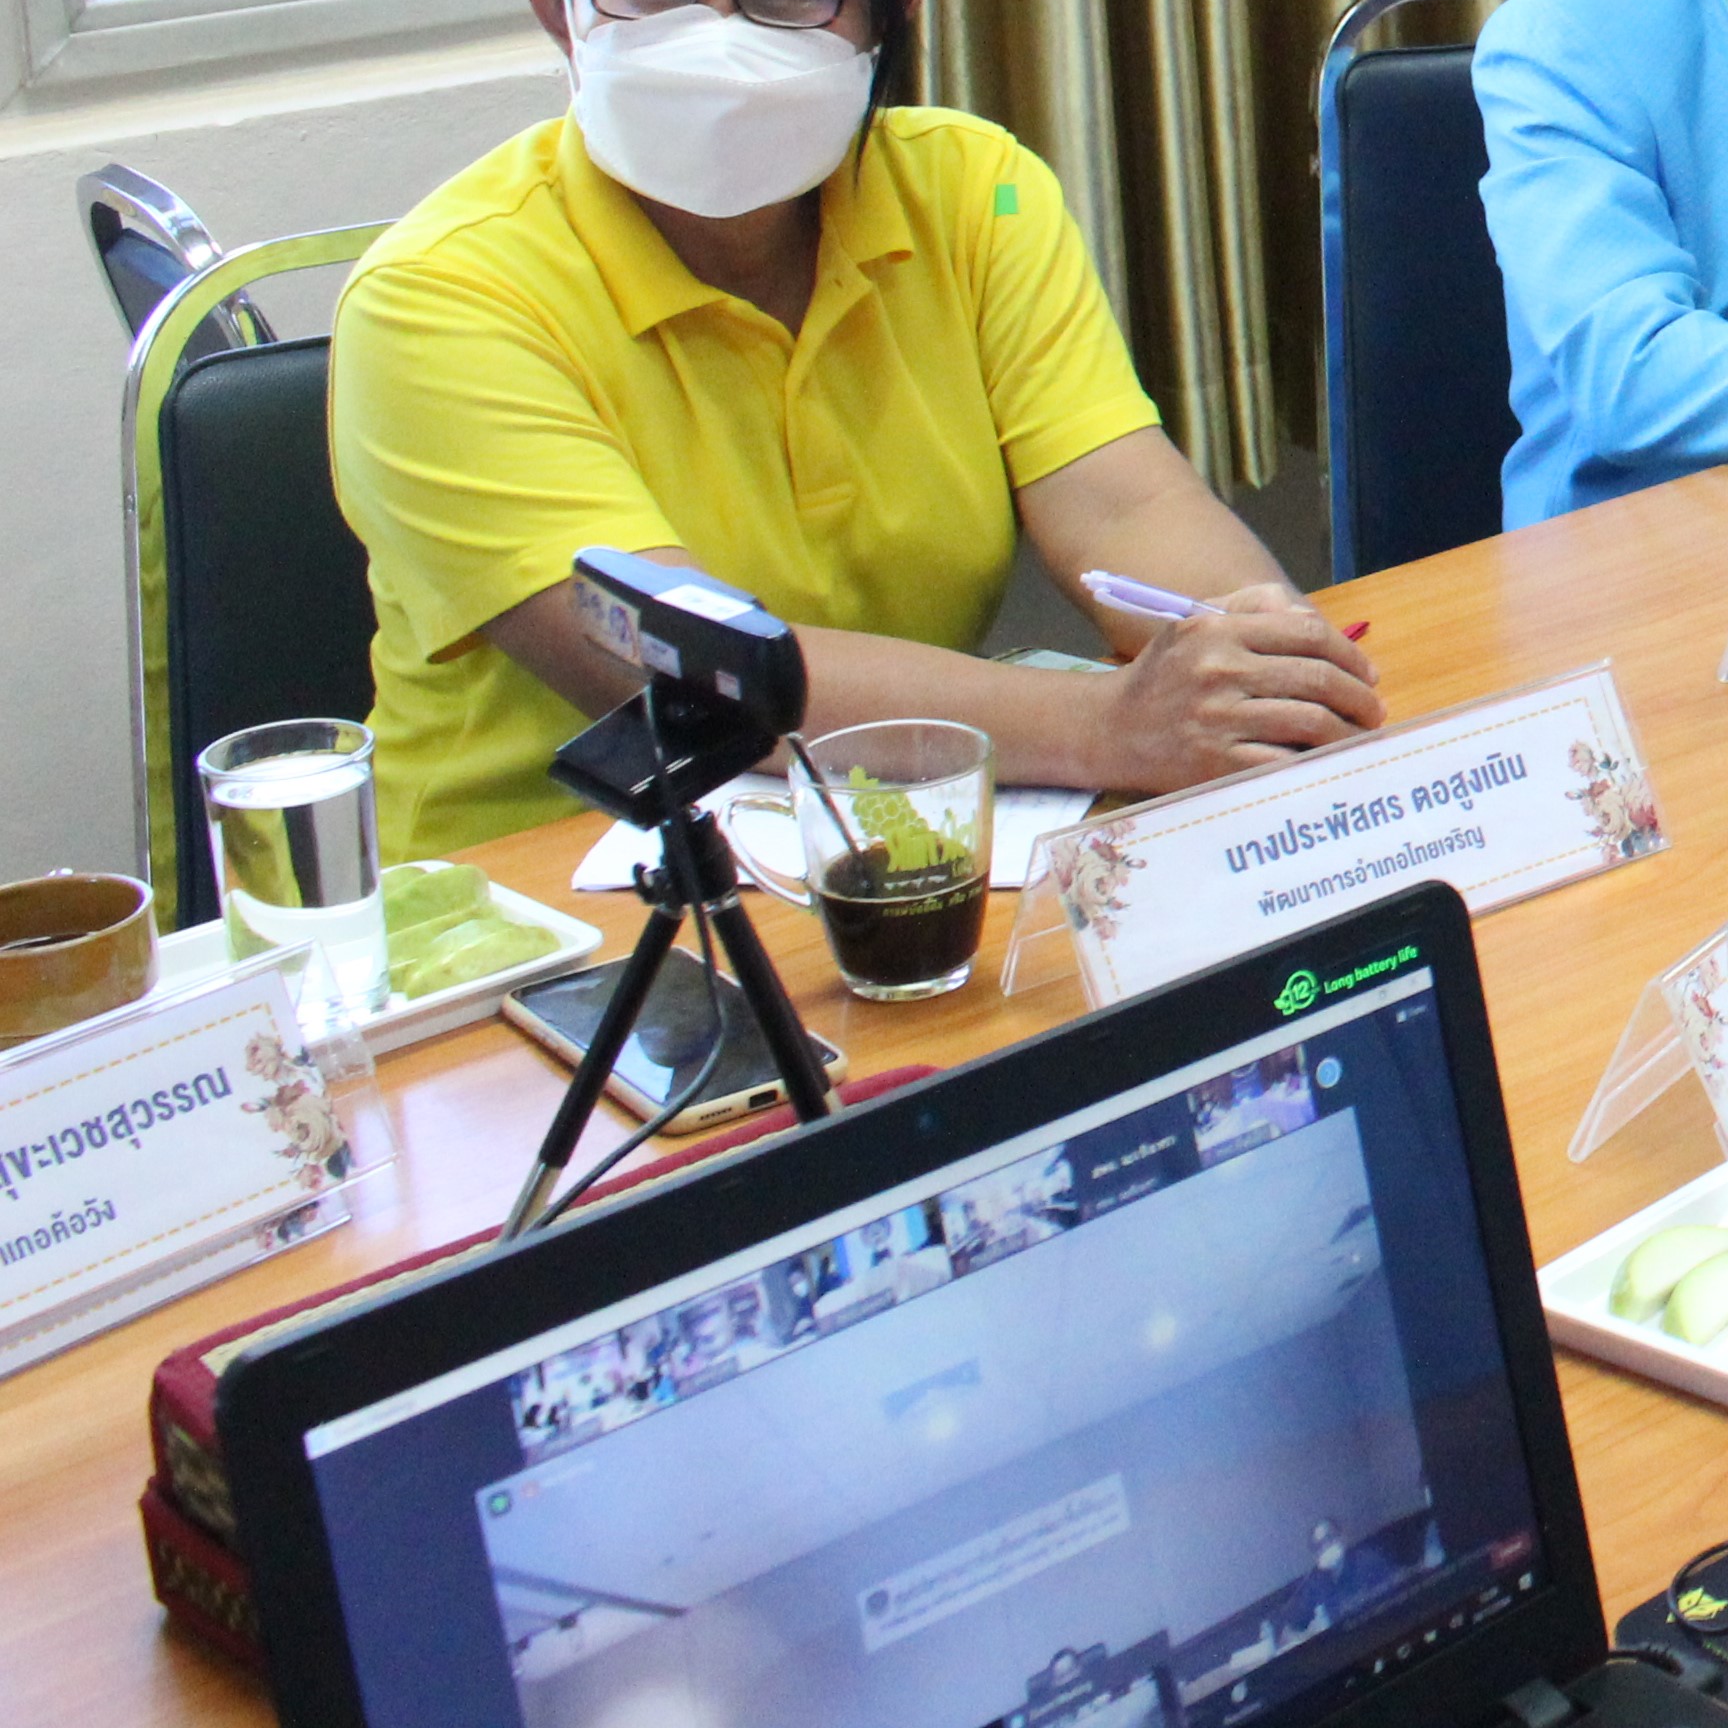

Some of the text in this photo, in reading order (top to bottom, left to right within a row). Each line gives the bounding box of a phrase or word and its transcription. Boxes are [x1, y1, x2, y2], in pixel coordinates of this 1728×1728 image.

[1226, 793, 1404, 873] นางประพัสศร
[1257, 823, 1486, 917] พัฒนาการอำเภอไทยเจริญ
[1353, 951, 1400, 983] battery
[1397, 944, 1420, 964] life
